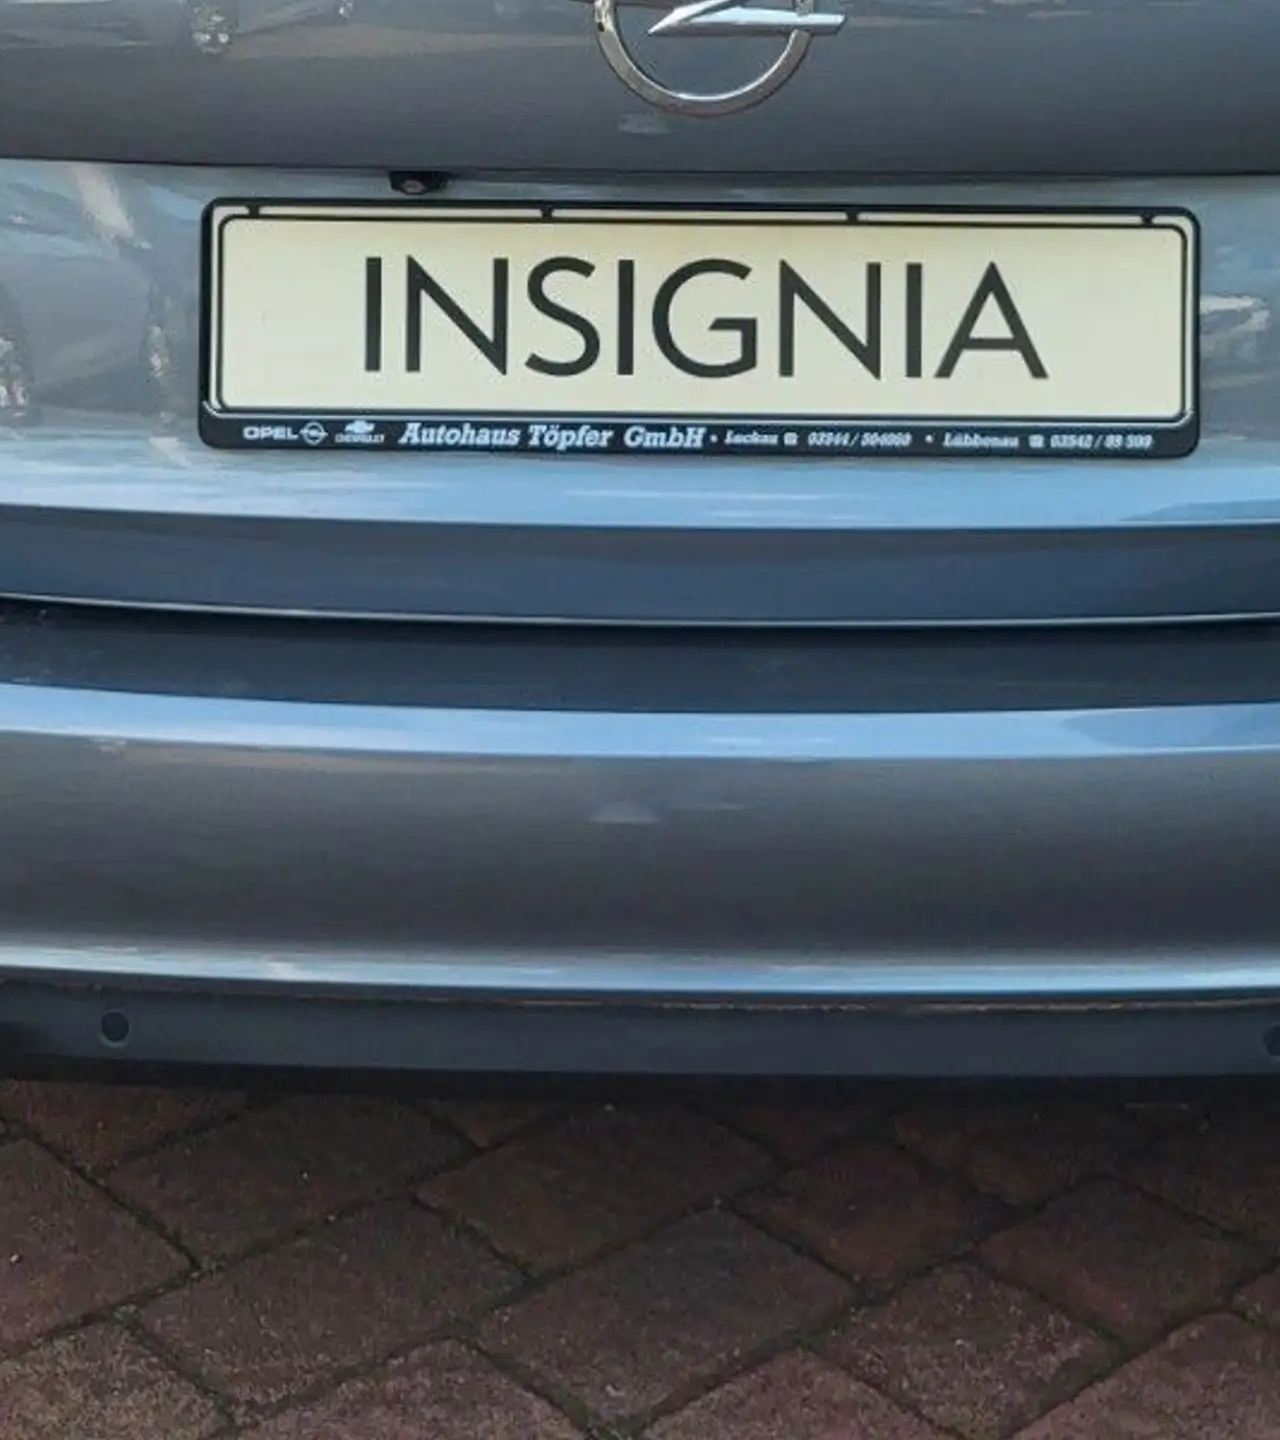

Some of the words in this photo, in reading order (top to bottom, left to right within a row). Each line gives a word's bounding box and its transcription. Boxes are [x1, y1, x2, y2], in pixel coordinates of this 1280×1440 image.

[366, 255, 1048, 380] INSIGNIA
[243, 426, 299, 440] OPEL
[398, 422, 521, 446] Autohaus
[528, 423, 613, 451] Töpfer
[623, 426, 707, 448] GmbH
